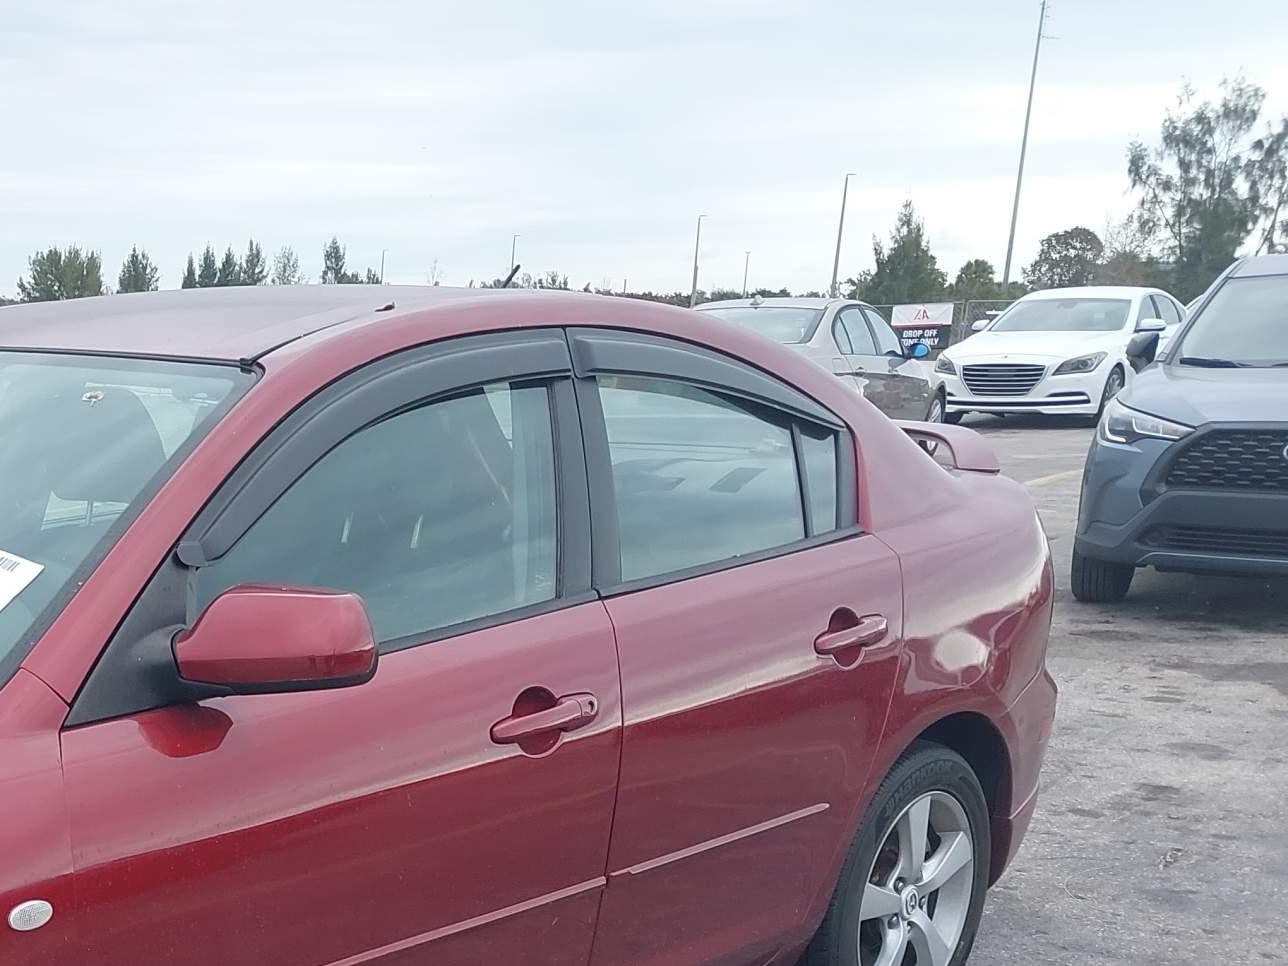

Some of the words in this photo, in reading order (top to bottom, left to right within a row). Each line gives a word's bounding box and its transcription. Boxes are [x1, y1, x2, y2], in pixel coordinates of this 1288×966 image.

[902, 330, 923, 338] DROP
[924, 329, 938, 337] OFF
[920, 337, 939, 346] ONLY
